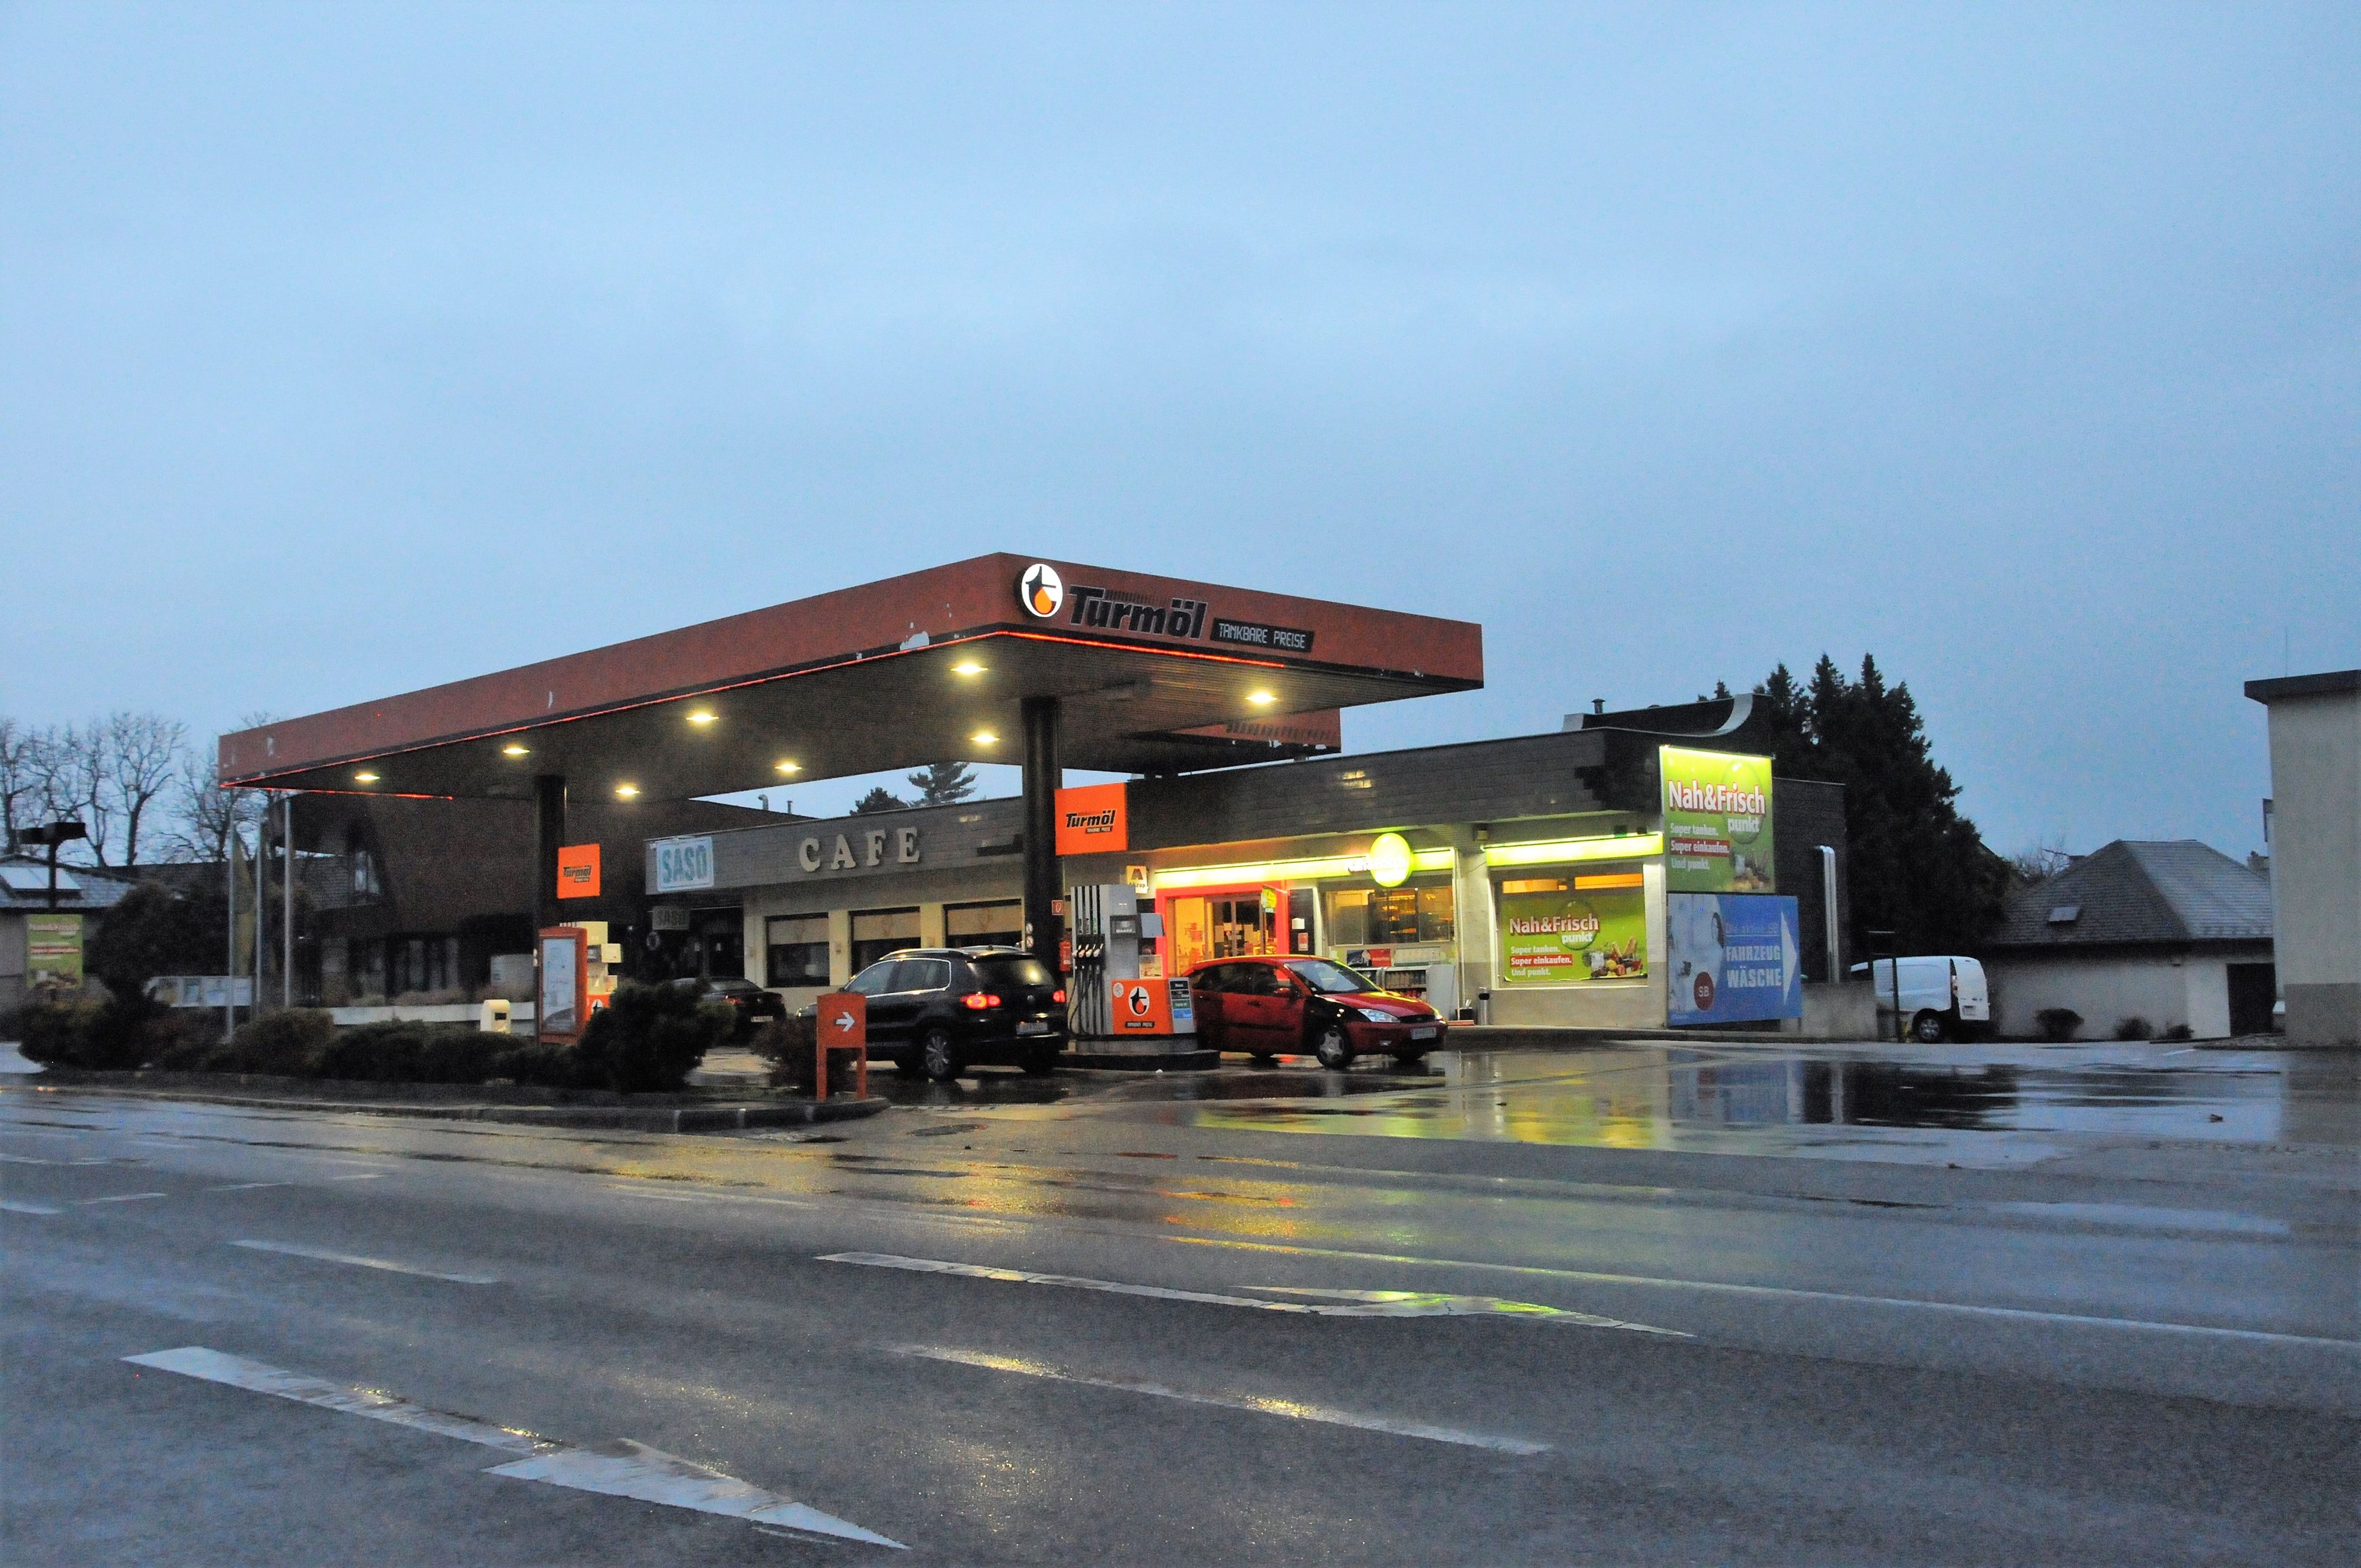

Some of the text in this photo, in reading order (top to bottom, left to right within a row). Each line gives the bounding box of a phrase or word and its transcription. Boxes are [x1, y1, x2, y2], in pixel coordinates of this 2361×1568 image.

[1069, 585, 1208, 640] Turmöl
[1219, 623, 1306, 649] TANKBARE PREISE
[1668, 779, 1766, 816] Nah&Frisch
[1066, 809, 1116, 828] Turmöl
[1727, 816, 1760, 834] punkt
[1670, 823, 1692, 837] Super
[799, 827, 920, 872] CAFE
[1670, 840, 1731, 855] Super einkaufen.
[1509, 913, 1600, 935] Nah&Frisch
[1562, 932, 1594, 944] punkt
[1511, 946, 1532, 955] Super
[1726, 945, 1781, 961] FAHRZEUG
[1511, 955, 1572, 967] Super einkaufen.
[1528, 968, 1551, 977] punkt.
[1726, 965, 1782, 988] WÄSCHE
[1698, 986, 1709, 997] SB
